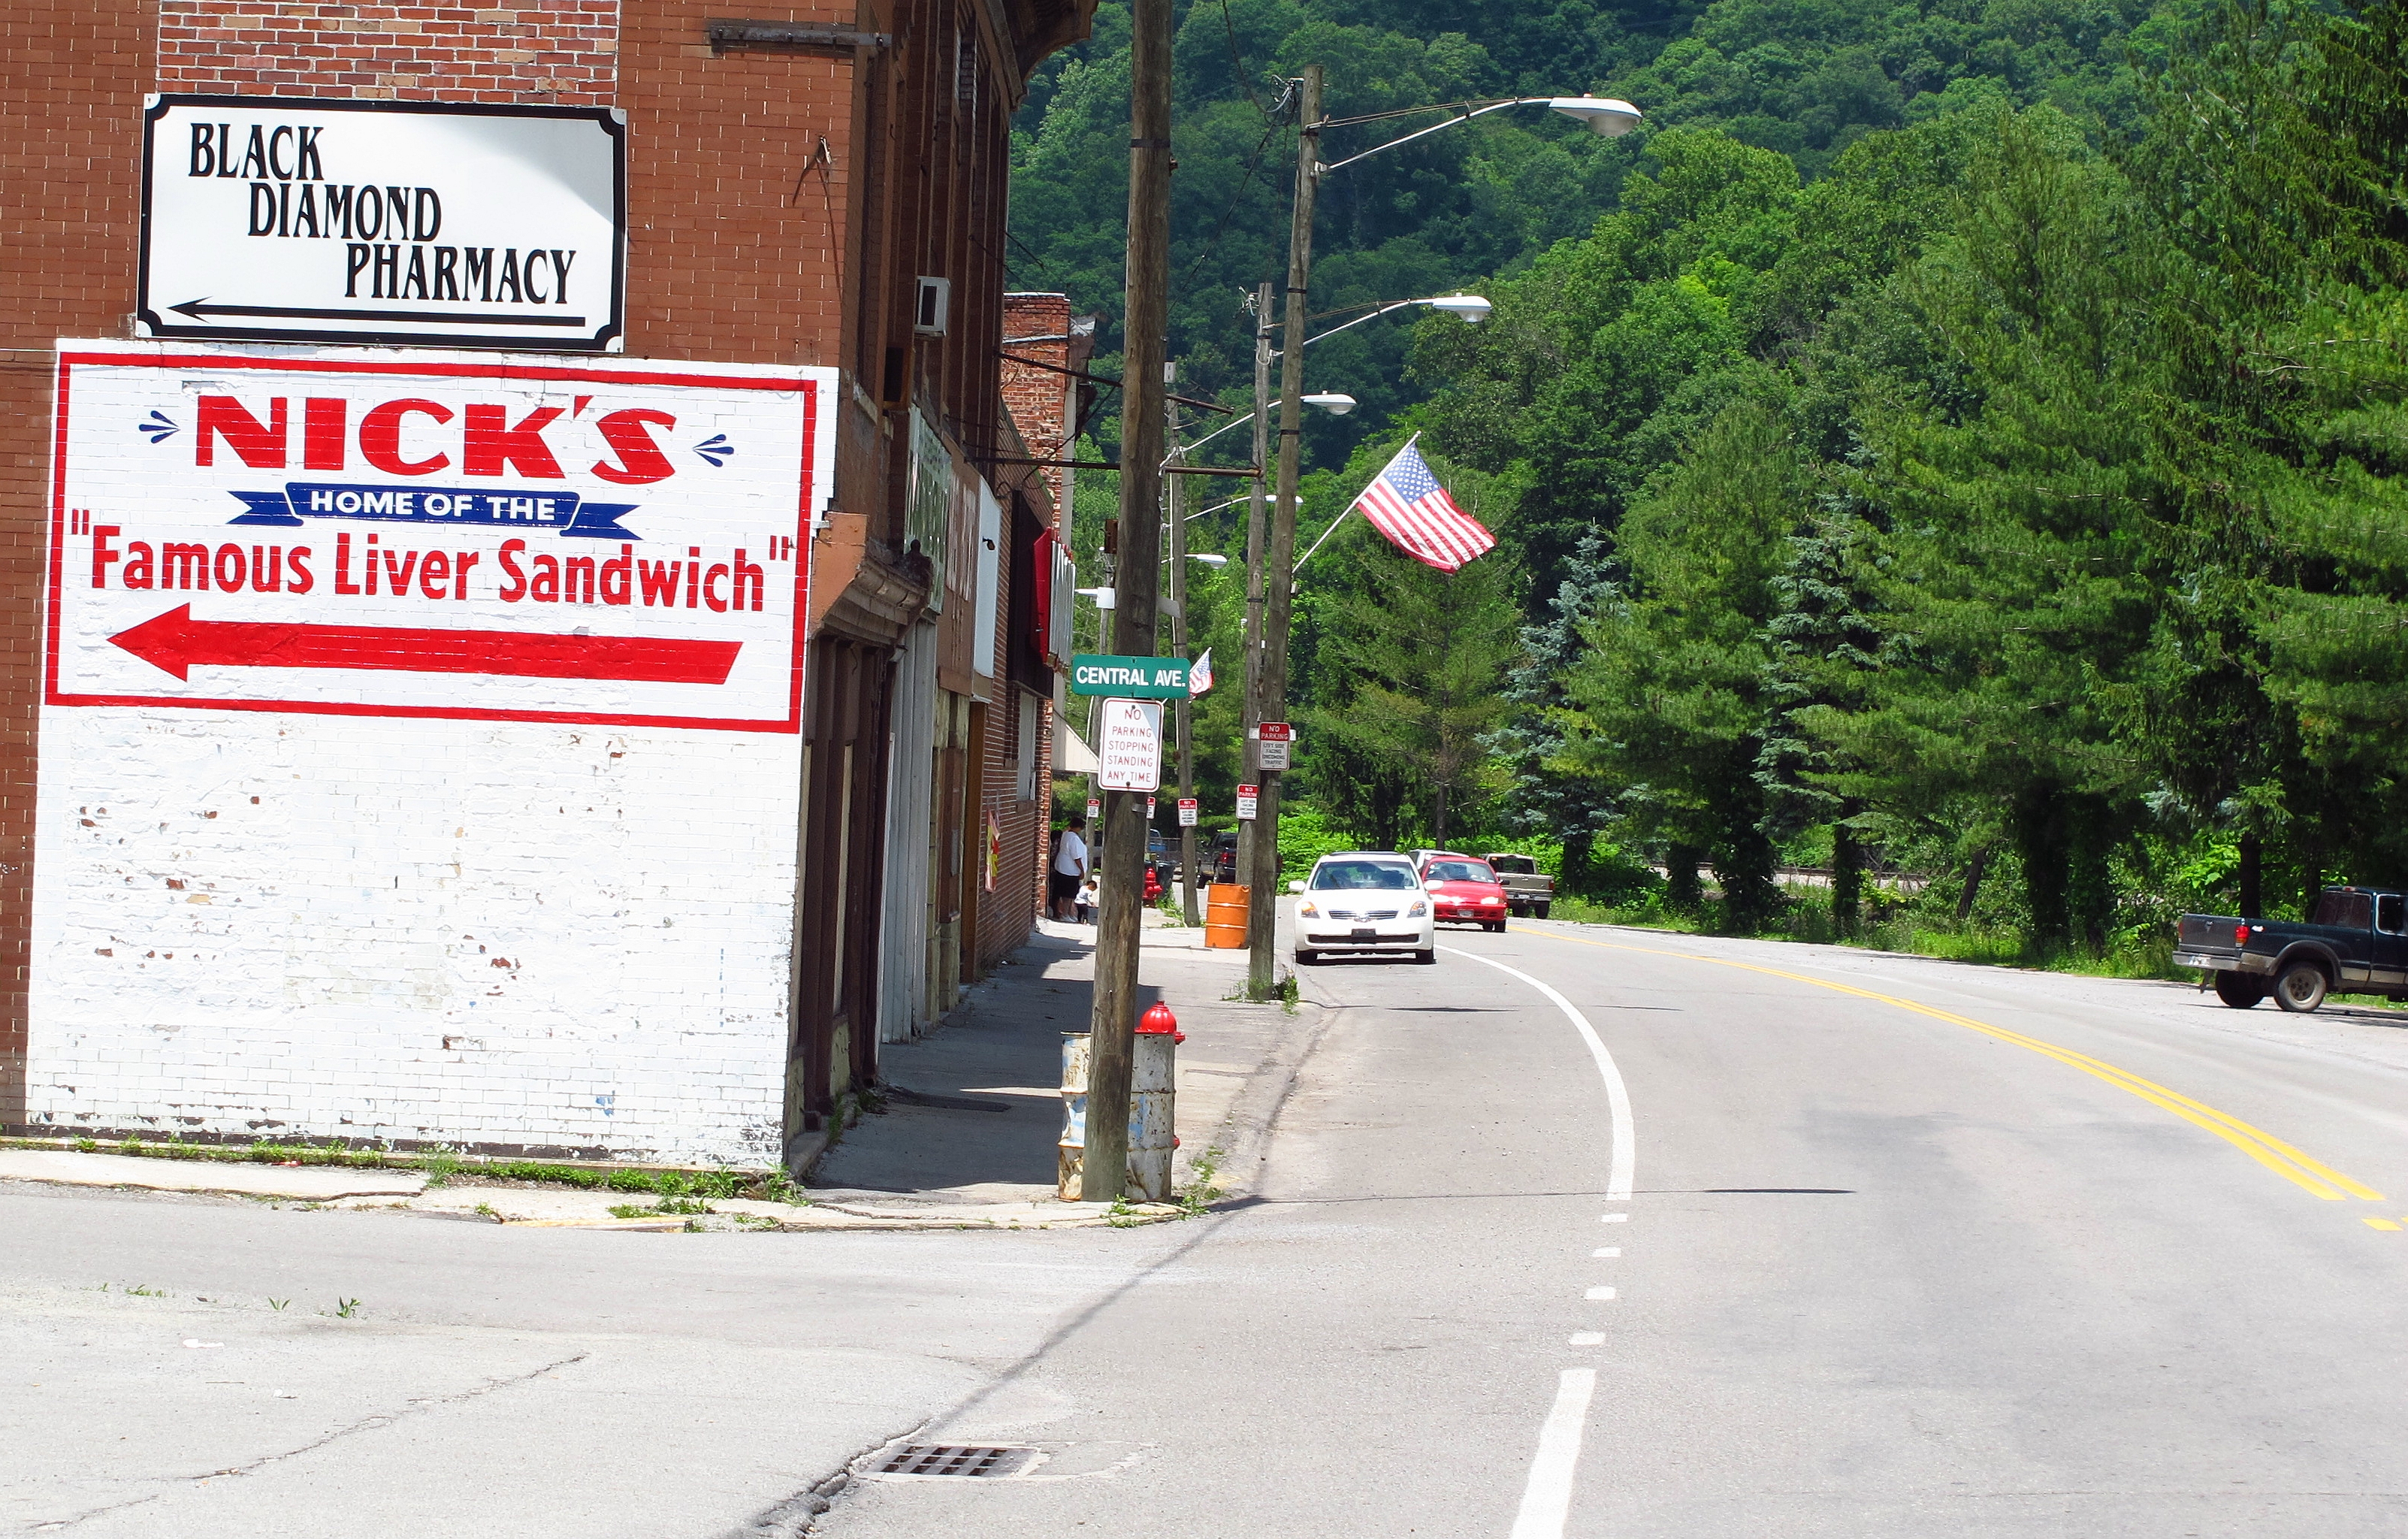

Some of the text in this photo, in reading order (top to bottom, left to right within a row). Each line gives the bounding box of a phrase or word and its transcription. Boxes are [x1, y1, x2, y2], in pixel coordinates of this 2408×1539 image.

[189, 122, 324, 180] BLACK
[248, 183, 441, 241] DIAMOND
[345, 243, 576, 304] PHARMACY
[196, 395, 676, 485] NICK'S
[310, 491, 555, 521] HOME OF THE
[71, 509, 789, 612] "Famous Liver Sandwich"
[1076, 667, 1186, 687] CENTRAL AVE.
[1125, 709, 1141, 720] NO
[1112, 726, 1152, 737] PARKING
[1108, 741, 1154, 752] STOPPING
[1107, 755, 1153, 767] STANDING
[1107, 770, 1151, 782] ANY TIME
